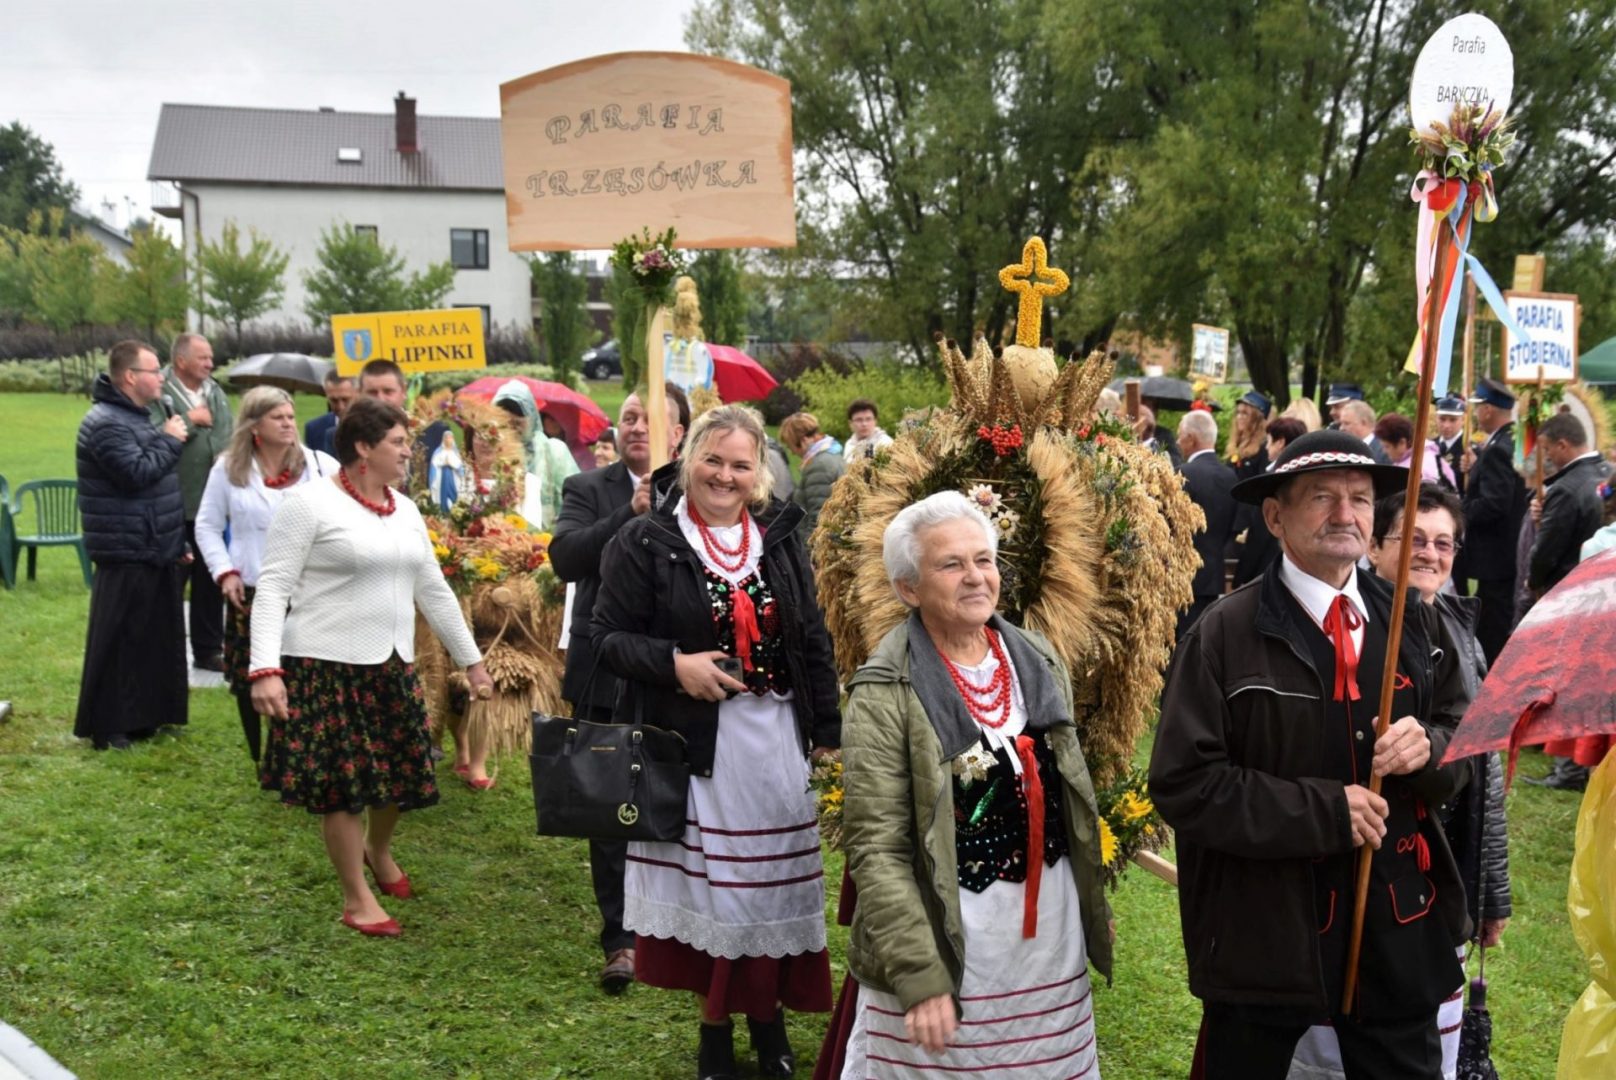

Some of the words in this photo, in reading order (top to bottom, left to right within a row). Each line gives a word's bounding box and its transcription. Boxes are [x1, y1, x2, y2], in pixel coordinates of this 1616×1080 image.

[1452, 35, 1486, 54] Parafia
[1436, 85, 1489, 103] BARYCZKA
[545, 102, 724, 145] PARAFIA
[525, 160, 757, 198] TRZĘSÓWKA
[393, 322, 471, 338] PARAFIA
[1517, 304, 1564, 333] PARAFIA
[390, 343, 474, 363] LIPINKI
[1509, 340, 1572, 372] STOBIERNA
